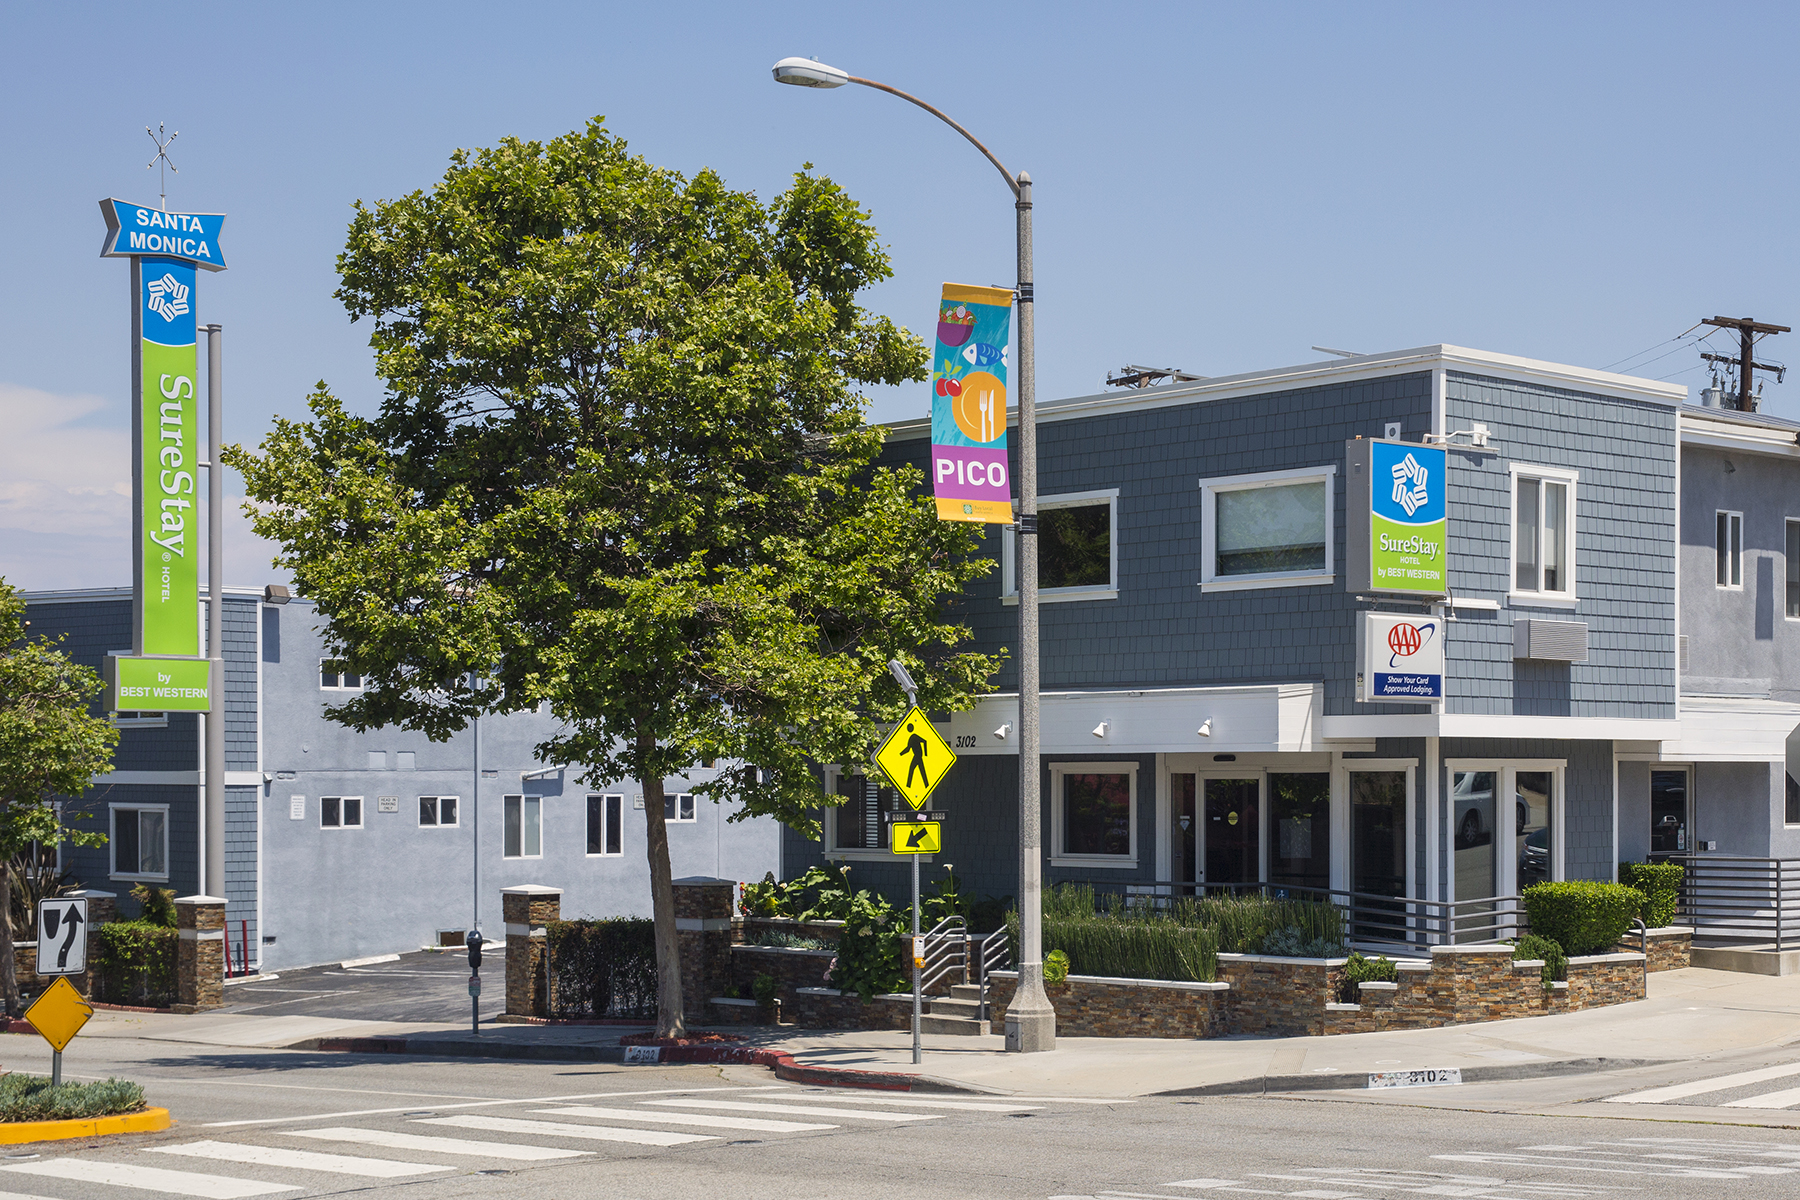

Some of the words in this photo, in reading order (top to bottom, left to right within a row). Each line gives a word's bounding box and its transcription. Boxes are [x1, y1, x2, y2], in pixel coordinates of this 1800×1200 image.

[136, 209, 204, 234] SANTA
[130, 231, 211, 258] MONICA
[936, 458, 1007, 487] PICO
[1400, 556, 1420, 565] HOTEL
[1378, 567, 1386, 578] by
[1387, 567, 1406, 577] BEST
[1407, 569, 1440, 580] WESTERN
[161, 566, 170, 603] HOTEL
[1391, 624, 1418, 656] AAA
[158, 672, 171, 684] by
[1387, 675, 1403, 684] Show
[1403, 676, 1416, 684] Your
[1416, 676, 1429, 684] Card
[120, 686, 151, 697] BEST
[153, 687, 208, 699] WESTERN
[1383, 685, 1411, 694] Approved
[956, 735, 976, 748] 3102
